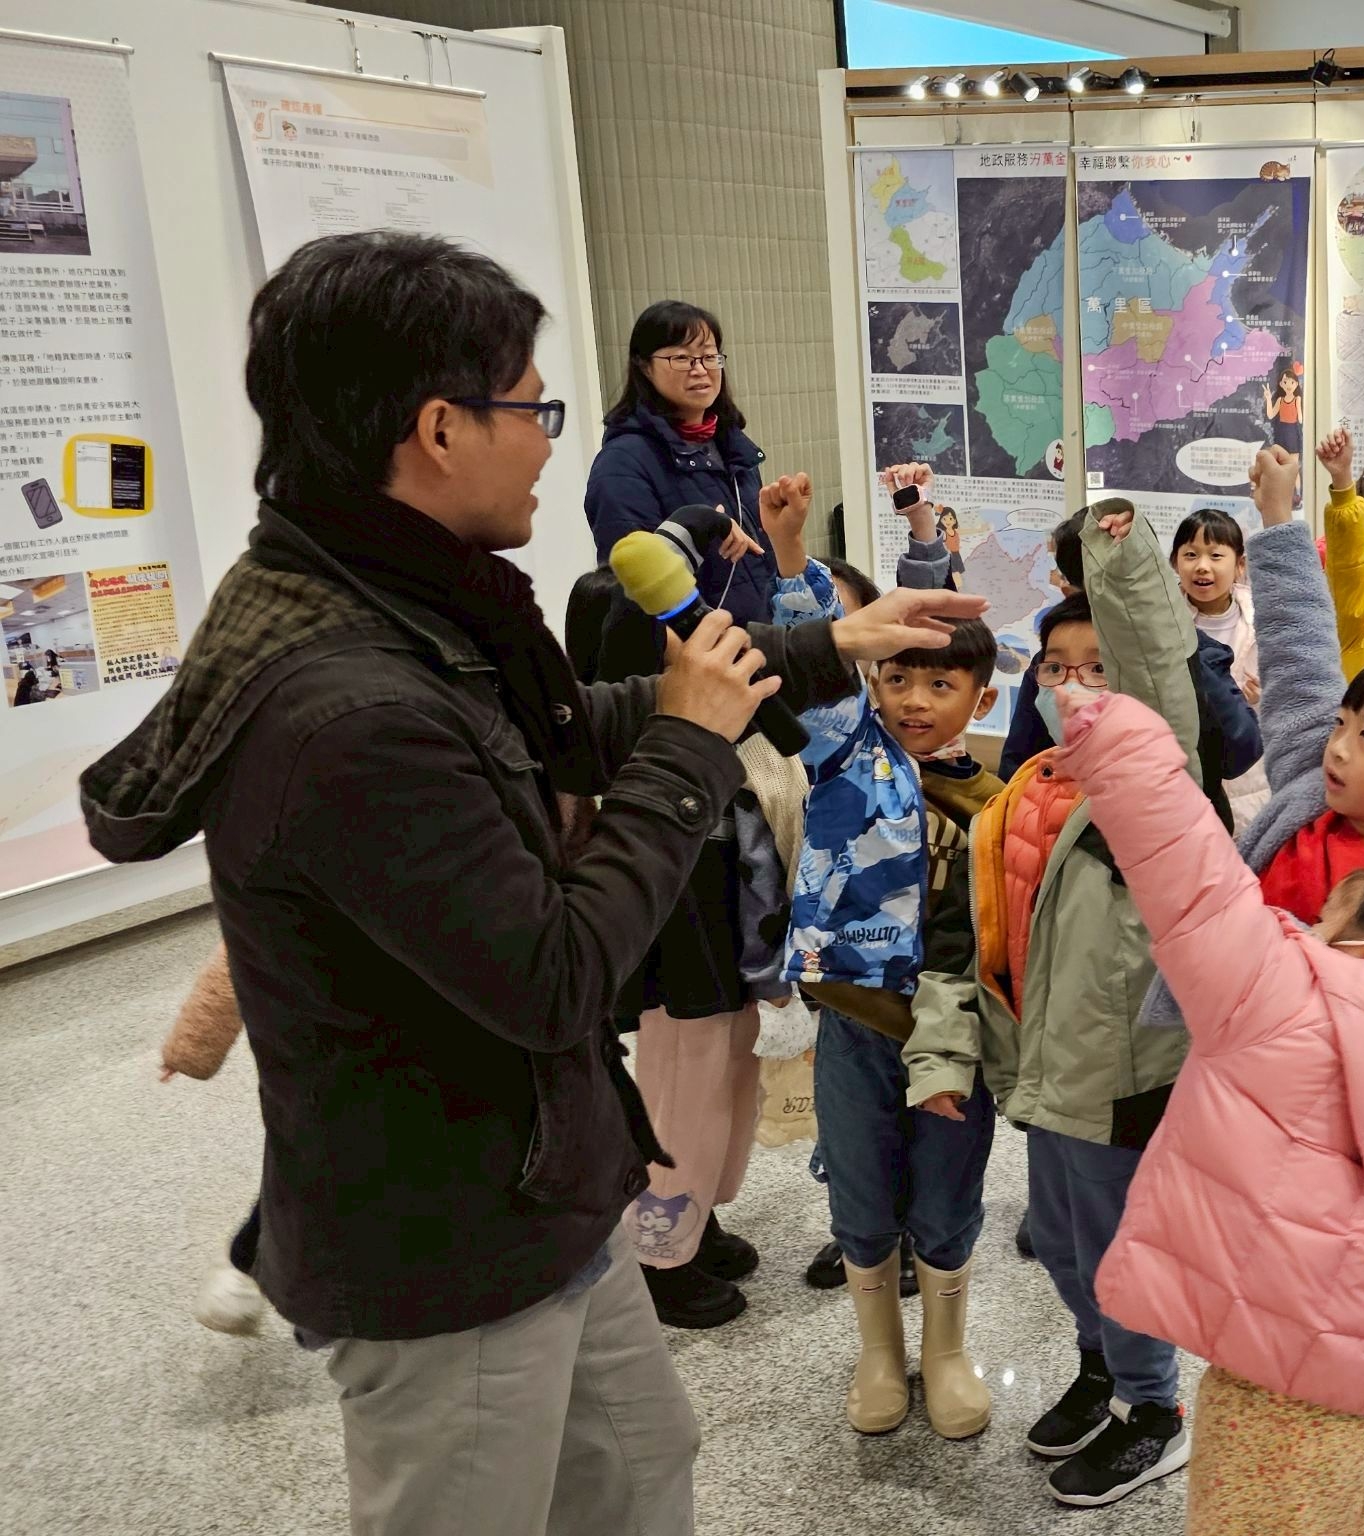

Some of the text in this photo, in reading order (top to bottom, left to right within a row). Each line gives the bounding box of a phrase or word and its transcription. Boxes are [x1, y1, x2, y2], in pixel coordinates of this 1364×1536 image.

[979, 152, 1066, 168] 地政服務汐萬金
[1086, 297, 1153, 314] 萬里區
